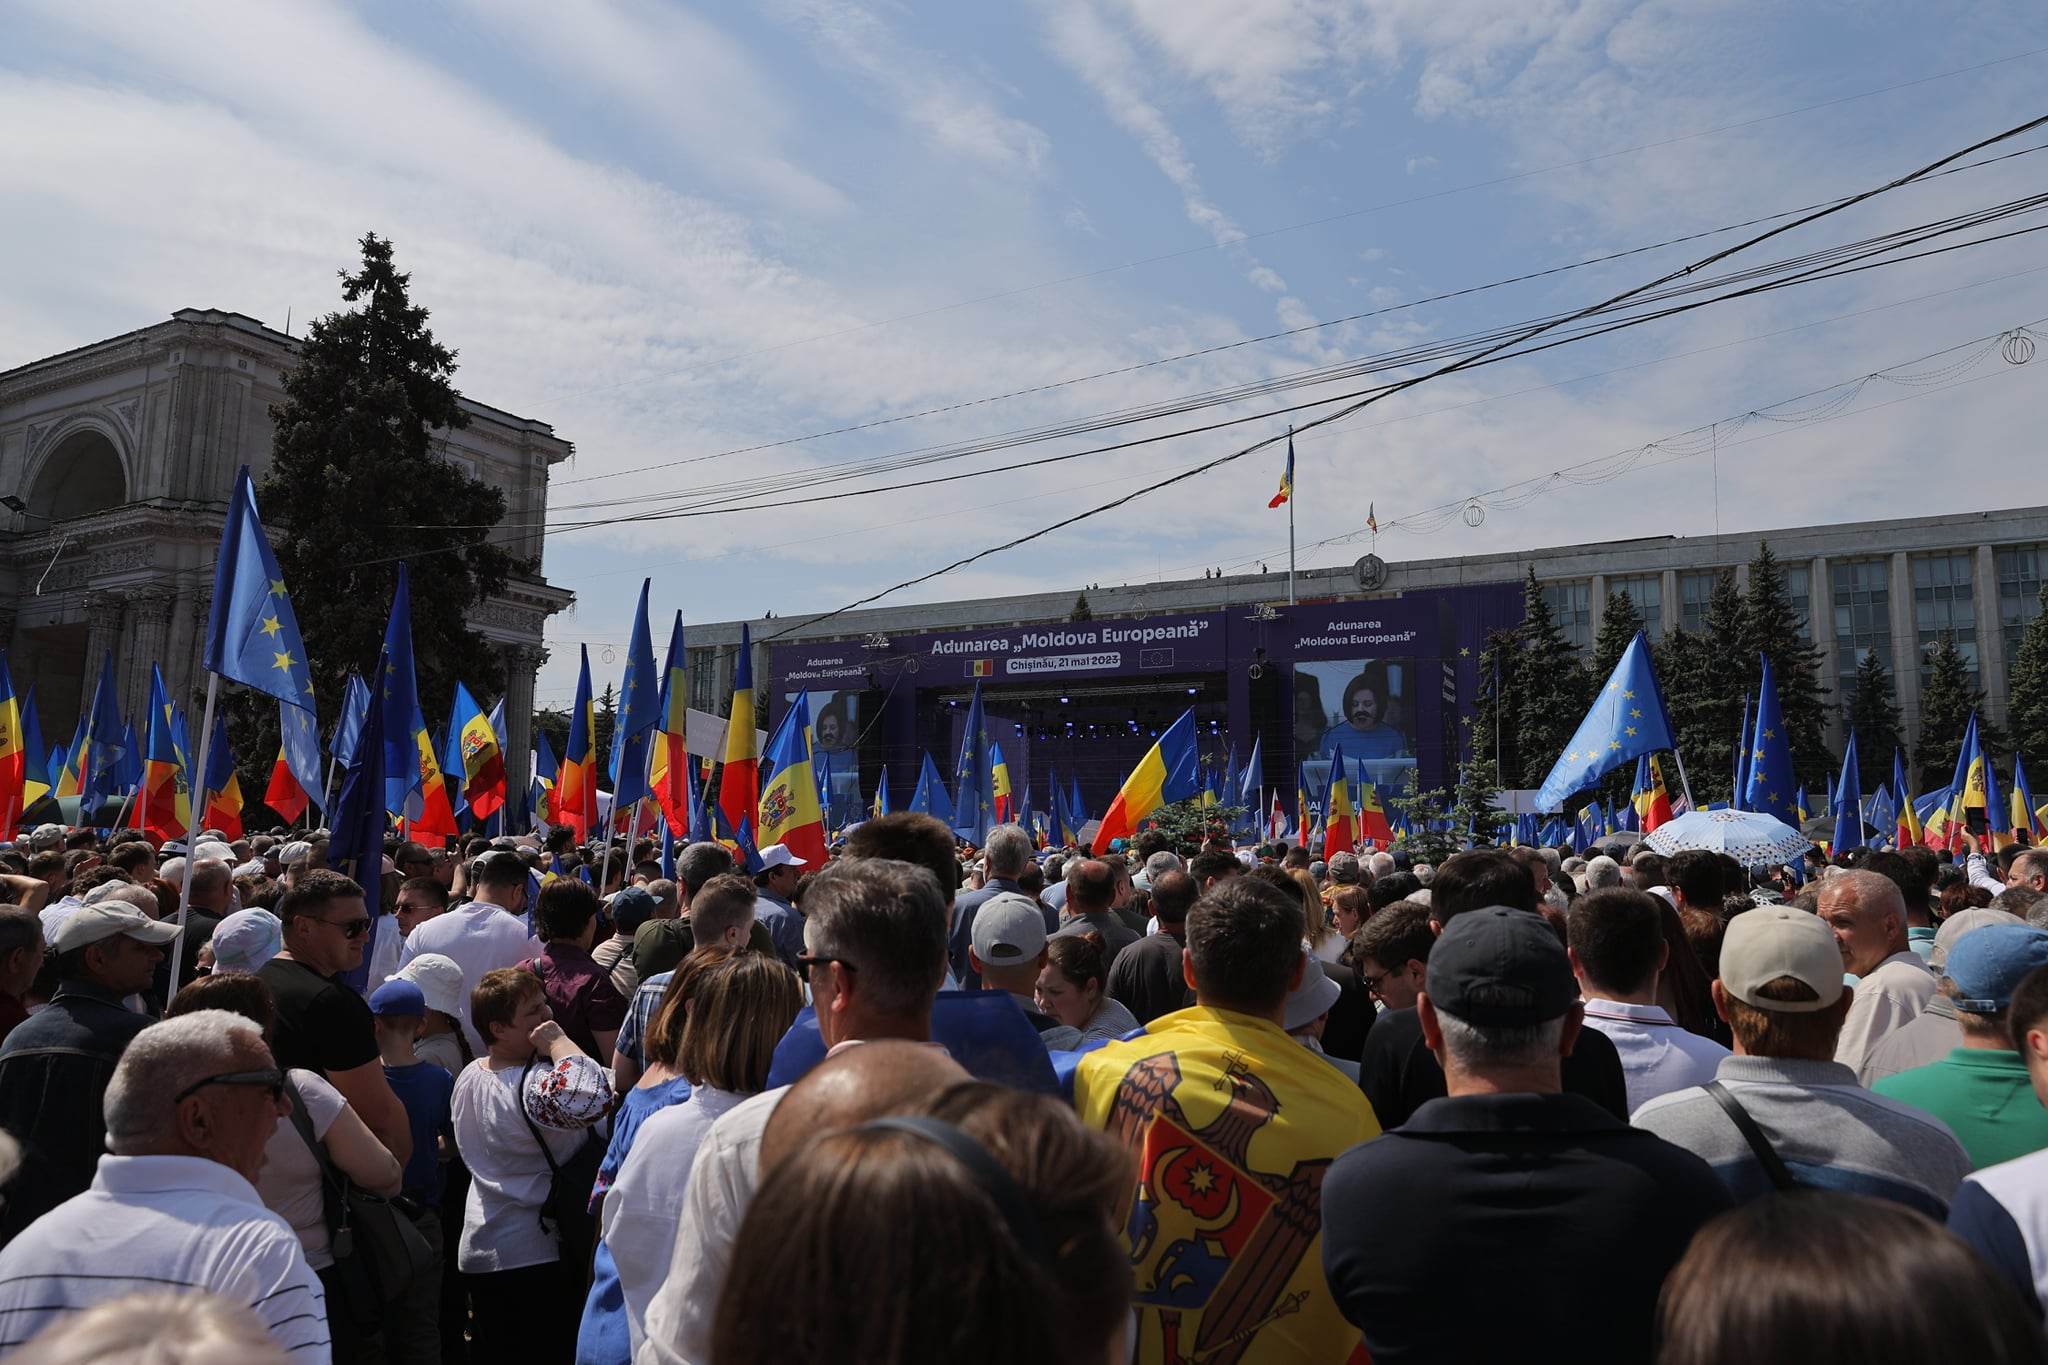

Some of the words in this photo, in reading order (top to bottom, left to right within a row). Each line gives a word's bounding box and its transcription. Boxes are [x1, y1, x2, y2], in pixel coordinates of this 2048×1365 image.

[1327, 620, 1382, 631] Adunarea
[931, 639, 1009, 655] Adunarea
[1013, 631, 1097, 654] „Moldova
[1102, 620, 1209, 644] Europeană”
[1294, 636, 1348, 649] „Moldova
[807, 657, 843, 667] Adunarea
[1058, 658, 1069, 667] 21
[1091, 655, 1119, 666] 2023
